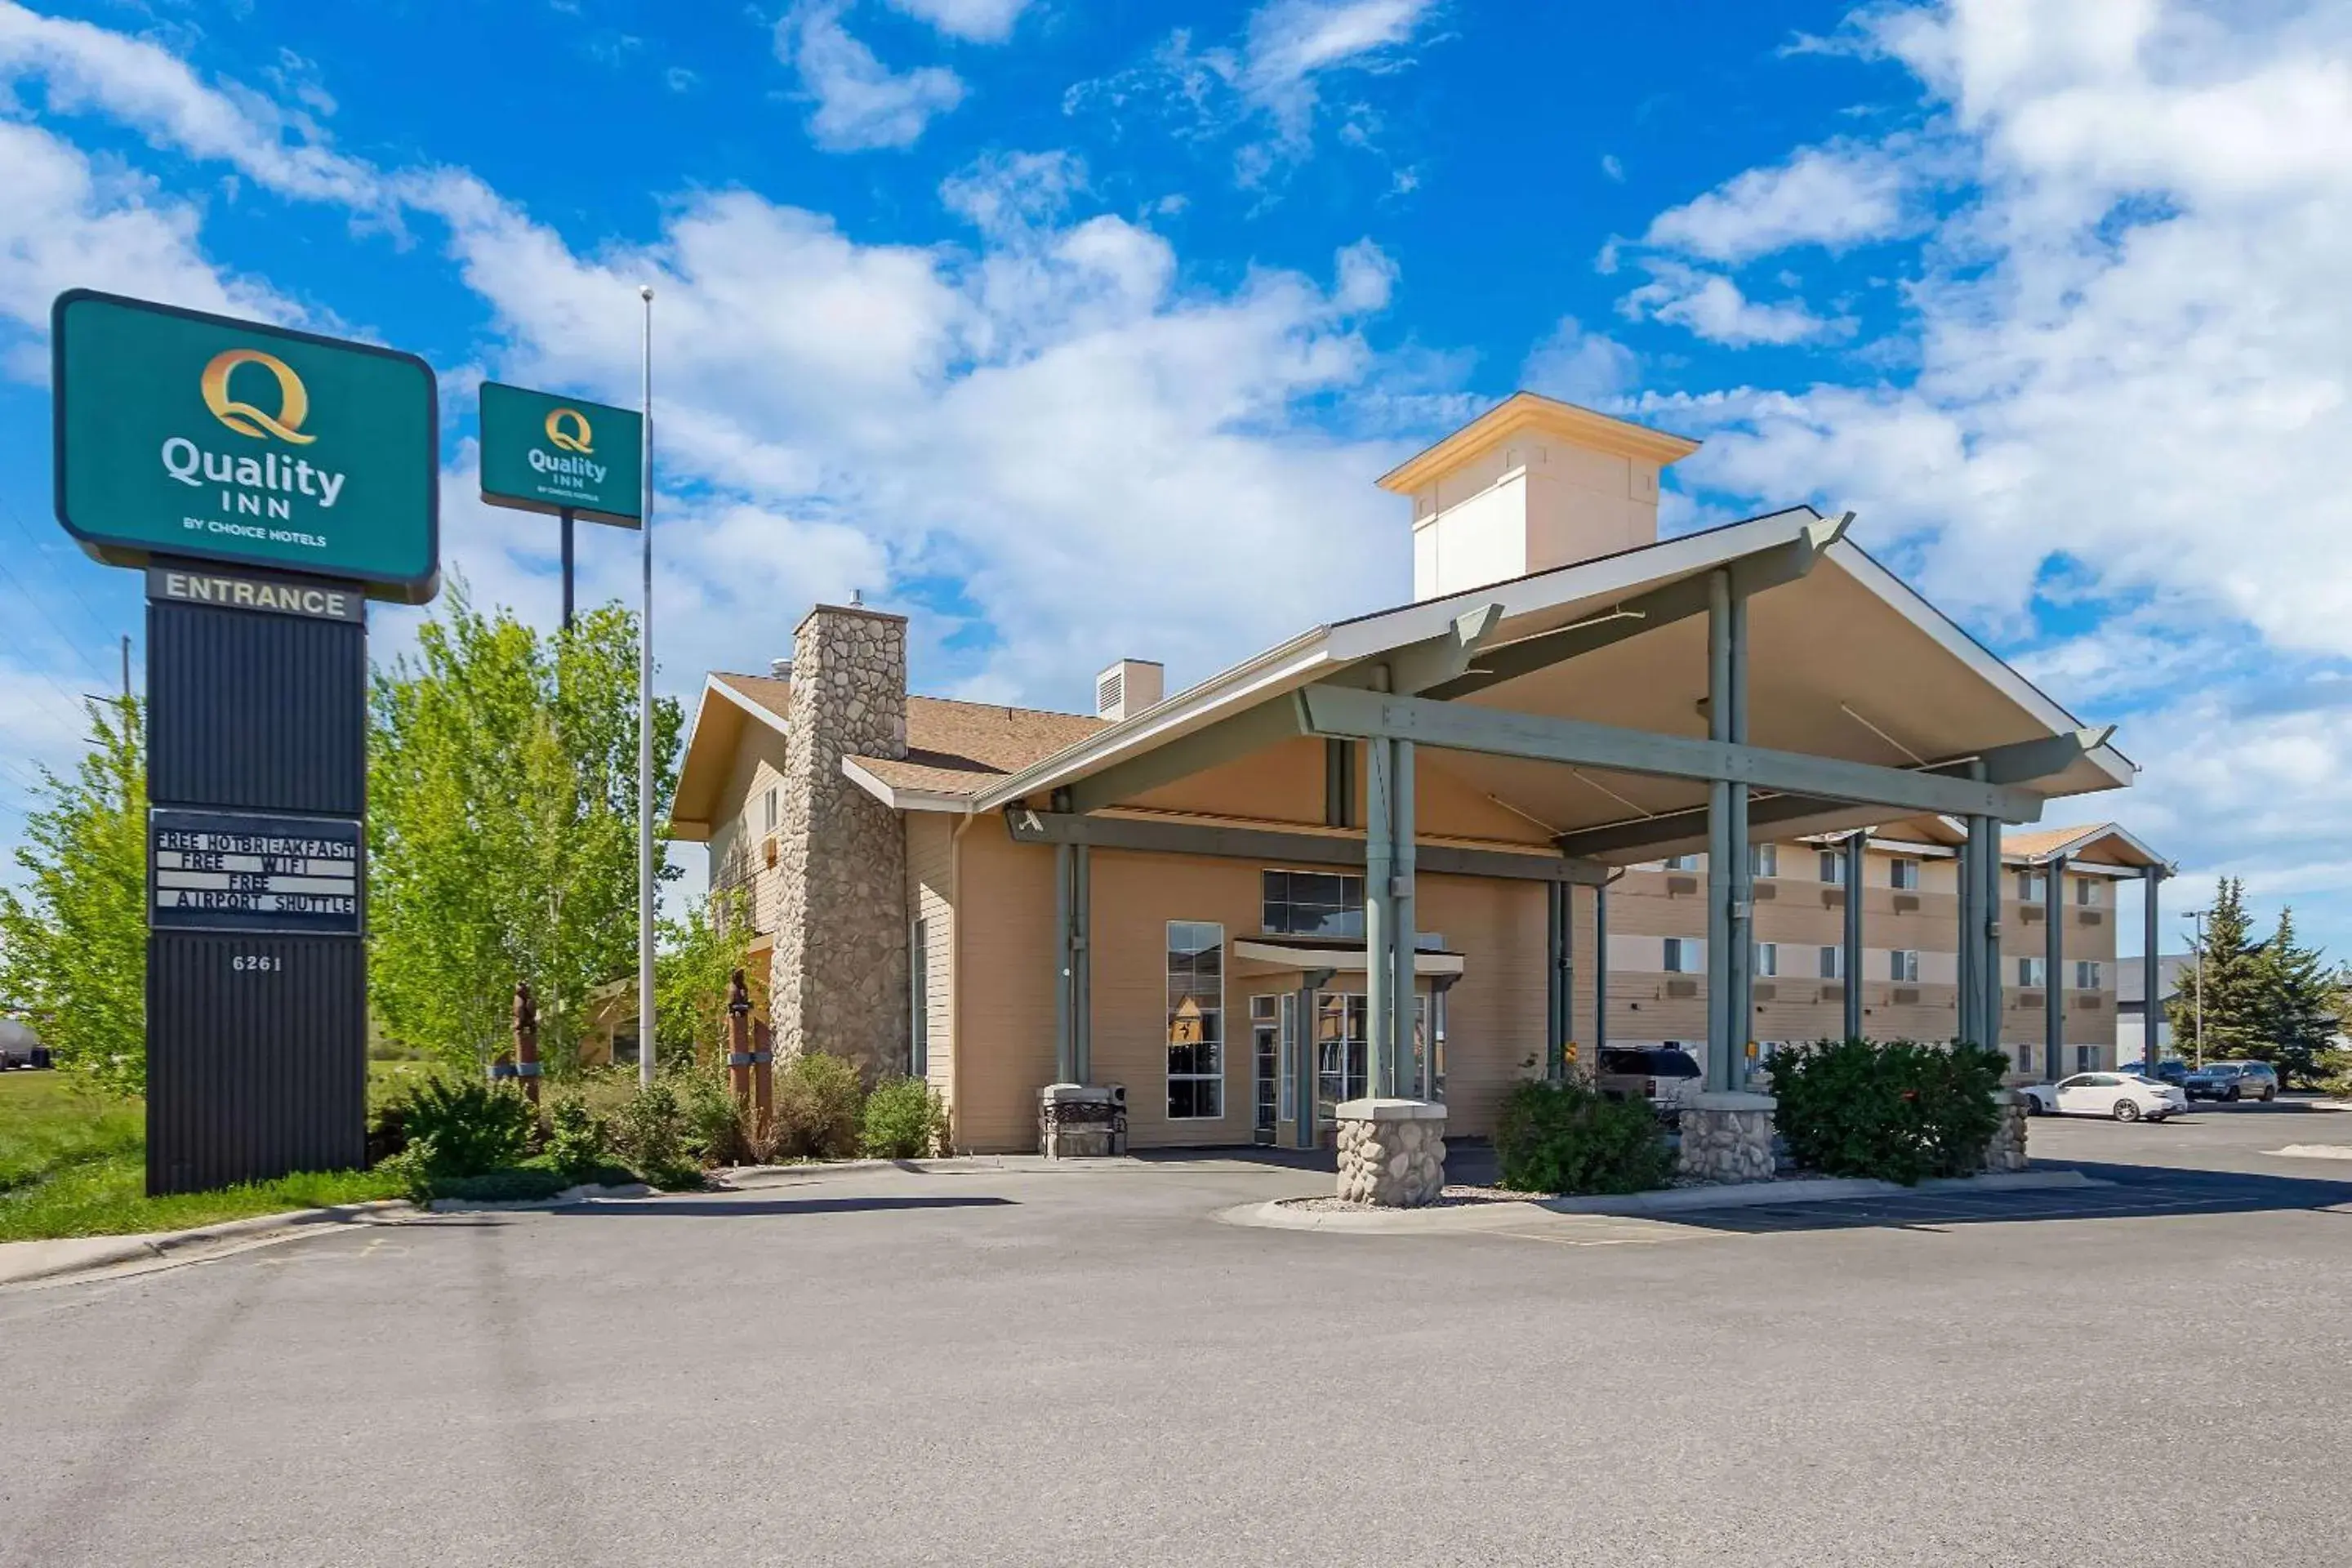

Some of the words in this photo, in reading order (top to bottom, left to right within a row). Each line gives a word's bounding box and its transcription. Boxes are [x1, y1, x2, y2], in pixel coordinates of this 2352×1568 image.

[201, 349, 318, 444] Q
[546, 408, 594, 453] Q
[162, 437, 345, 507] Quality
[528, 448, 607, 483] Quality
[553, 474, 583, 488] INN
[222, 490, 290, 519] INN
[183, 517, 204, 529] BY
[207, 521, 266, 539] CHOICE
[269, 528, 327, 547] HOTELS
[166, 573, 345, 617] ENTRANCE
[157, 832, 199, 850] FREE
[182, 853, 224, 871] FREE
[261, 858, 307, 874] WIFI
[229, 874, 270, 892] FREE
[177, 891, 261, 911] AIRPORT
[275, 896, 351, 913] SHUTTLE
[234, 956, 281, 971] 6261
